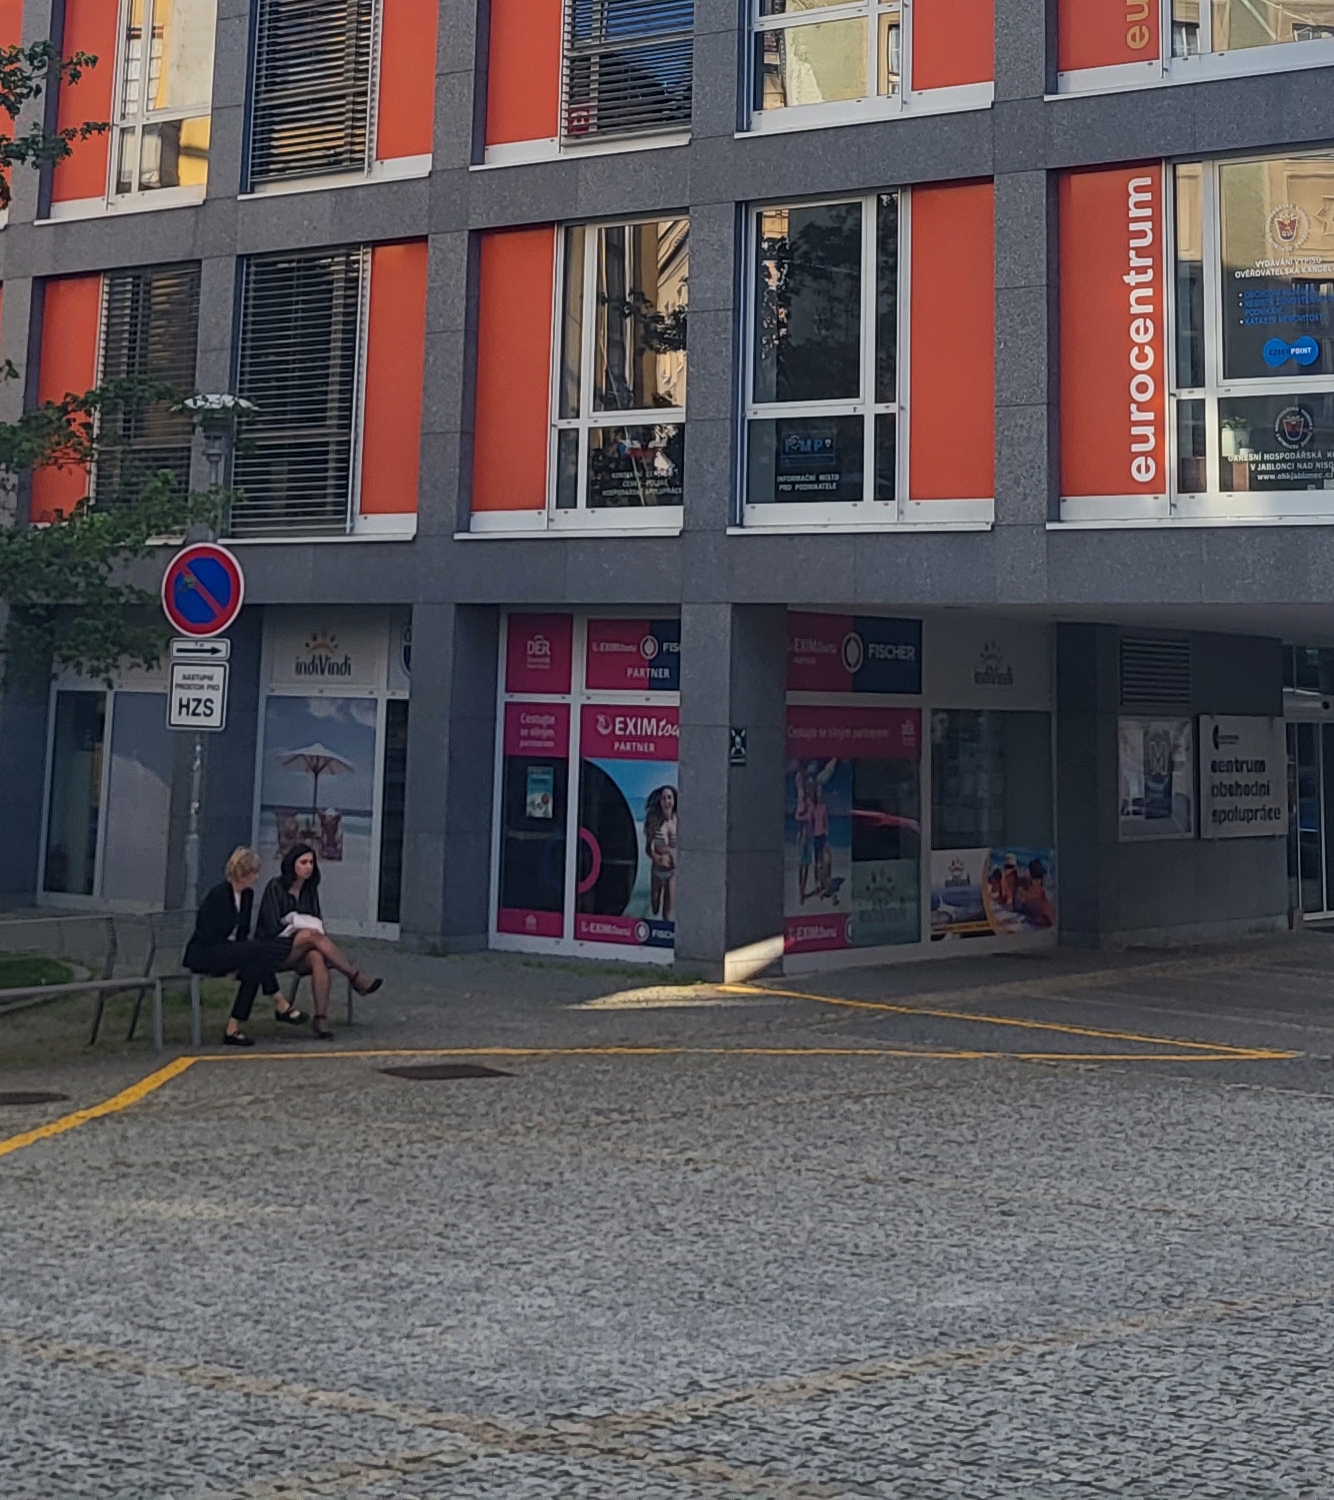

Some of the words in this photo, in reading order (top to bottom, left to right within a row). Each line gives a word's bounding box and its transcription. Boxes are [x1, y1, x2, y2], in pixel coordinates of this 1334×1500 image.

[1122, 176, 1153, 483] eurocentrum
[1290, 346, 1312, 355] POINT
[1257, 462, 1295, 471] JABLONCI
[1297, 461, 1314, 469] NAD
[868, 643, 916, 660] FISCHER
[295, 655, 352, 676] indiVindi
[627, 667, 671, 679] PARTNER
[178, 697, 215, 717] HZS
[613, 741, 655, 752] PARTNER
[1211, 758, 1266, 773] centrum
[1211, 780, 1270, 797] obchodní
[1211, 805, 1281, 824] spolupráce
